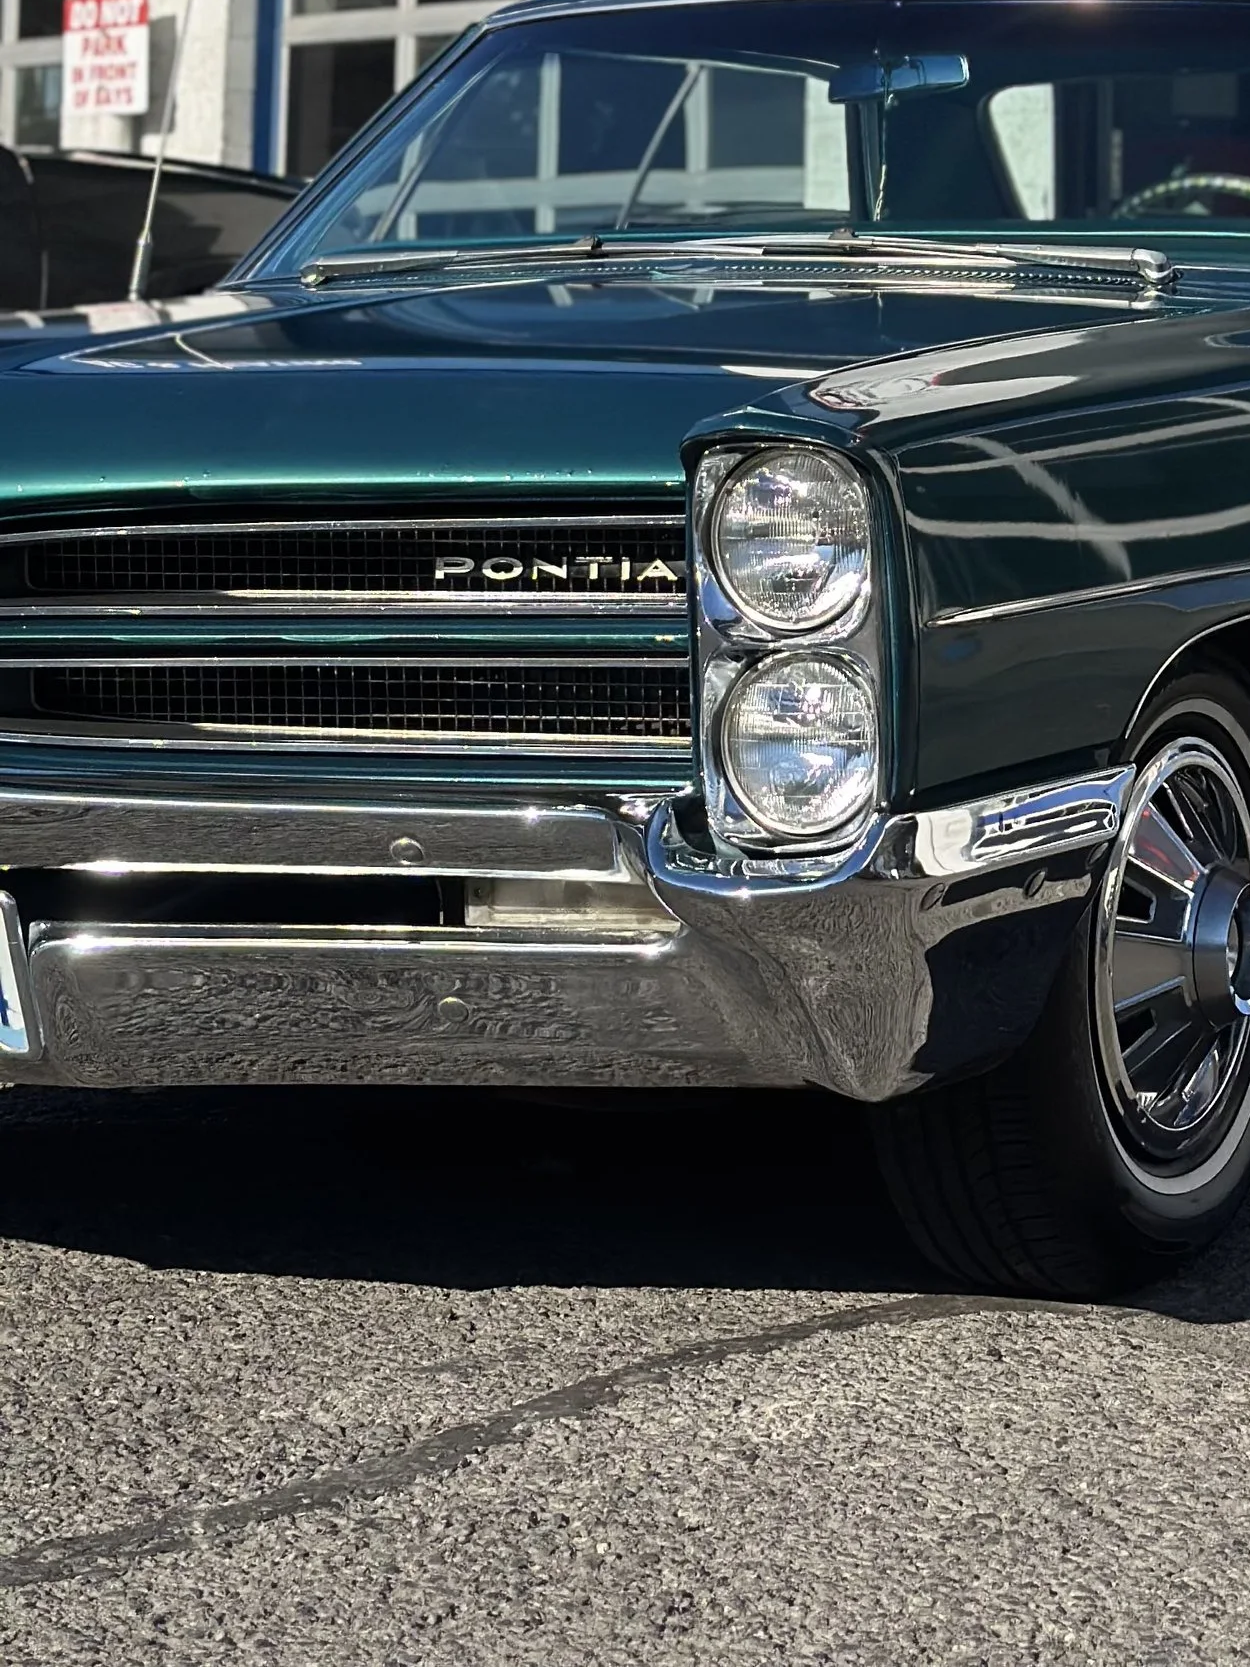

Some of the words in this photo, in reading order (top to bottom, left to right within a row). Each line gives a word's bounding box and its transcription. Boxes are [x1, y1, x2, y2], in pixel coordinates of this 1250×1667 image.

[71, 0, 98, 30] DO
[81, 35, 128, 56] PARK
[88, 61, 138, 82] FRONT
[434, 556, 679, 581] PONTIA
